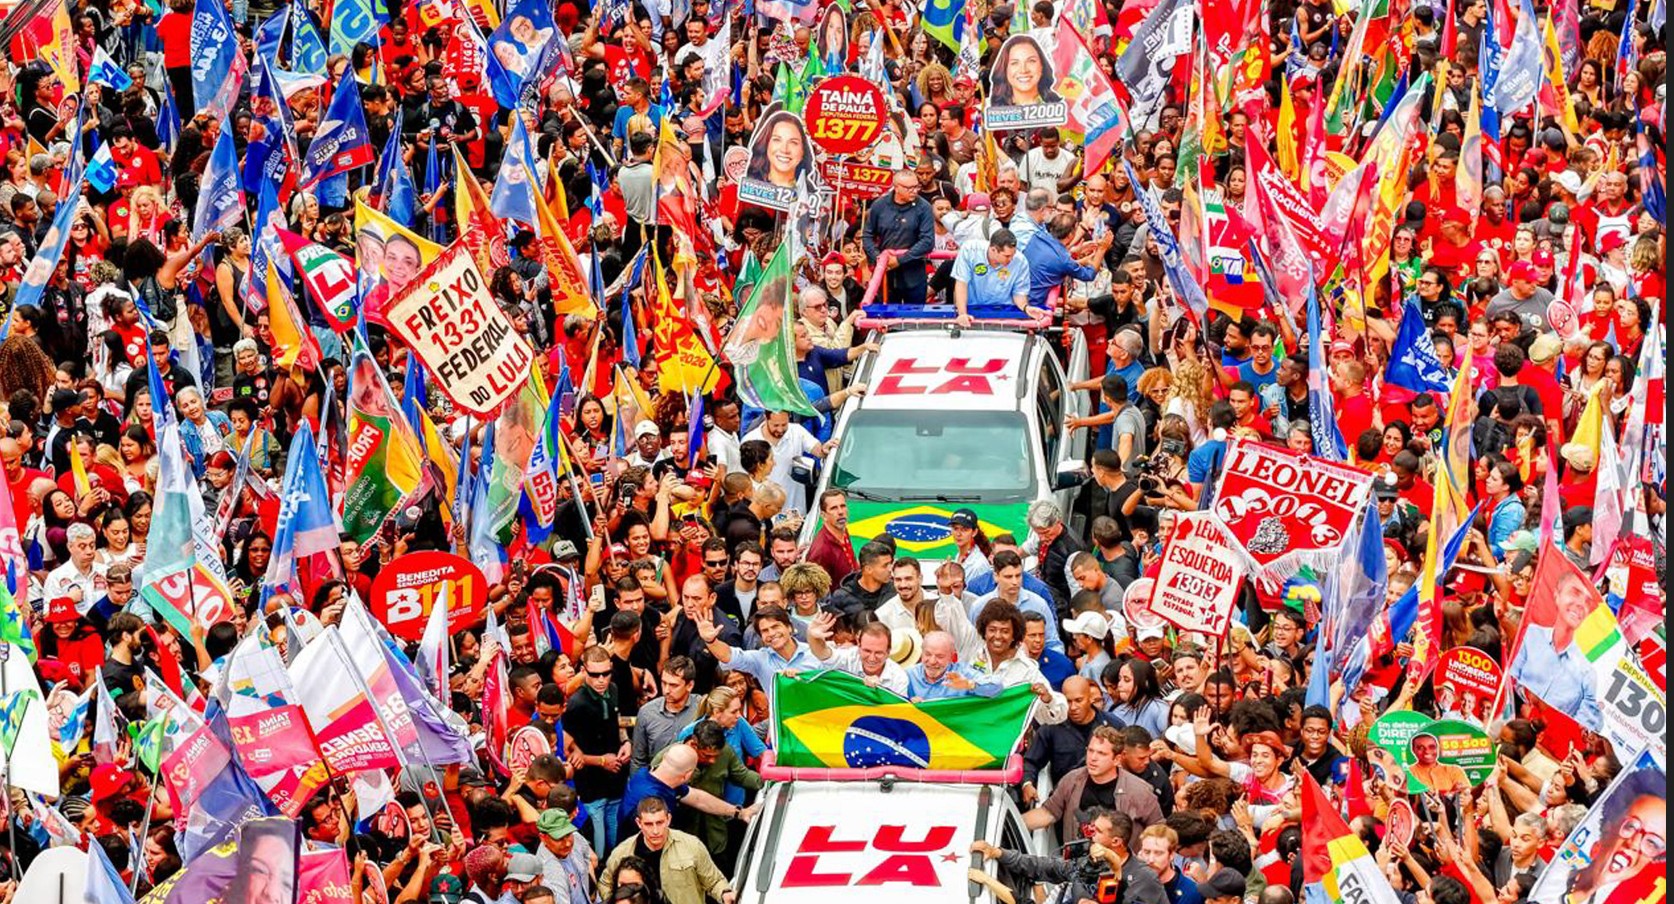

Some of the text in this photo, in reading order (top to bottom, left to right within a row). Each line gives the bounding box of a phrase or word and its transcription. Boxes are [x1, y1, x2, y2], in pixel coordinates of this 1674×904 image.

[821, 102, 877, 115] DE PAULA
[853, 113, 878, 121] FEDERAL
[989, 113, 1022, 121] NEVES
[1023, 103, 1063, 119] 12000
[815, 119, 877, 142] 1377
[853, 168, 891, 183] 1377
[742, 186, 775, 200] NEVES
[405, 267, 479, 340] FREIXO
[431, 299, 488, 355] 1331
[437, 316, 509, 388] FEDERAL
[680, 352, 706, 368] 2026
[469, 342, 529, 406] DO LULA
[887, 358, 1009, 374] LU
[873, 375, 994, 396] LA
[1228, 451, 1359, 508] LEONEL
[396, 565, 456, 583] BENEDITA
[1169, 545, 1233, 586] ESQUERDA
[397, 577, 439, 589] SENADORA
[1175, 573, 1218, 601] 13013
[1162, 591, 1194, 608] DEPUTADO
[1163, 600, 1195, 618] ESTADUAL
[1204, 609, 1218, 627] PT
[1457, 650, 1492, 672] 1300
[1448, 659, 1498, 685] LINDBERGH
[1604, 668, 1666, 741] 130
[1393, 720, 1419, 730] defesa
[1379, 738, 1392, 746] dos
[1442, 738, 1488, 750] 50.500
[796, 825, 957, 853] LU
[781, 854, 942, 888] LA
